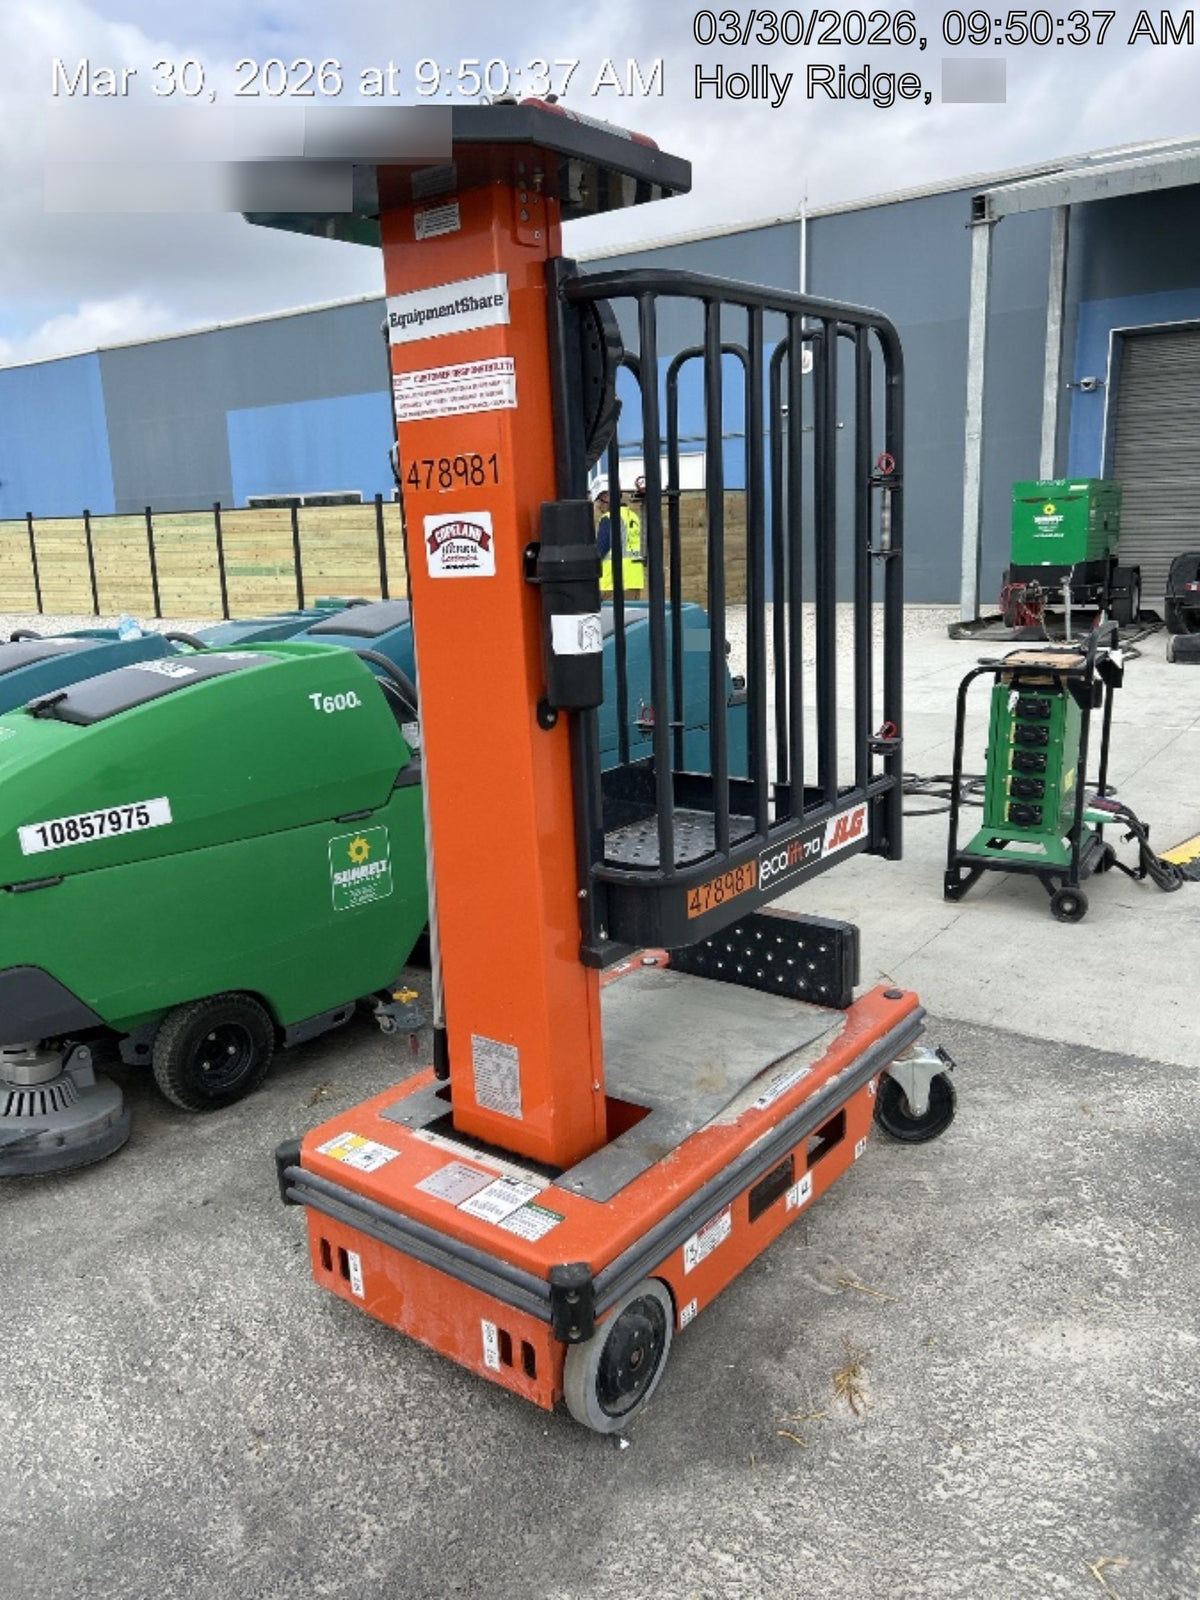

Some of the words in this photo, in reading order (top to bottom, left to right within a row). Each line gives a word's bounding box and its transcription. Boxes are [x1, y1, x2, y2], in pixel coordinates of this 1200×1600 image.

[389, 293, 504, 330] EquipmentShare
[407, 453, 499, 490] 478981
[36, 804, 151, 848] 10857975
[689, 862, 755, 912] 478981
